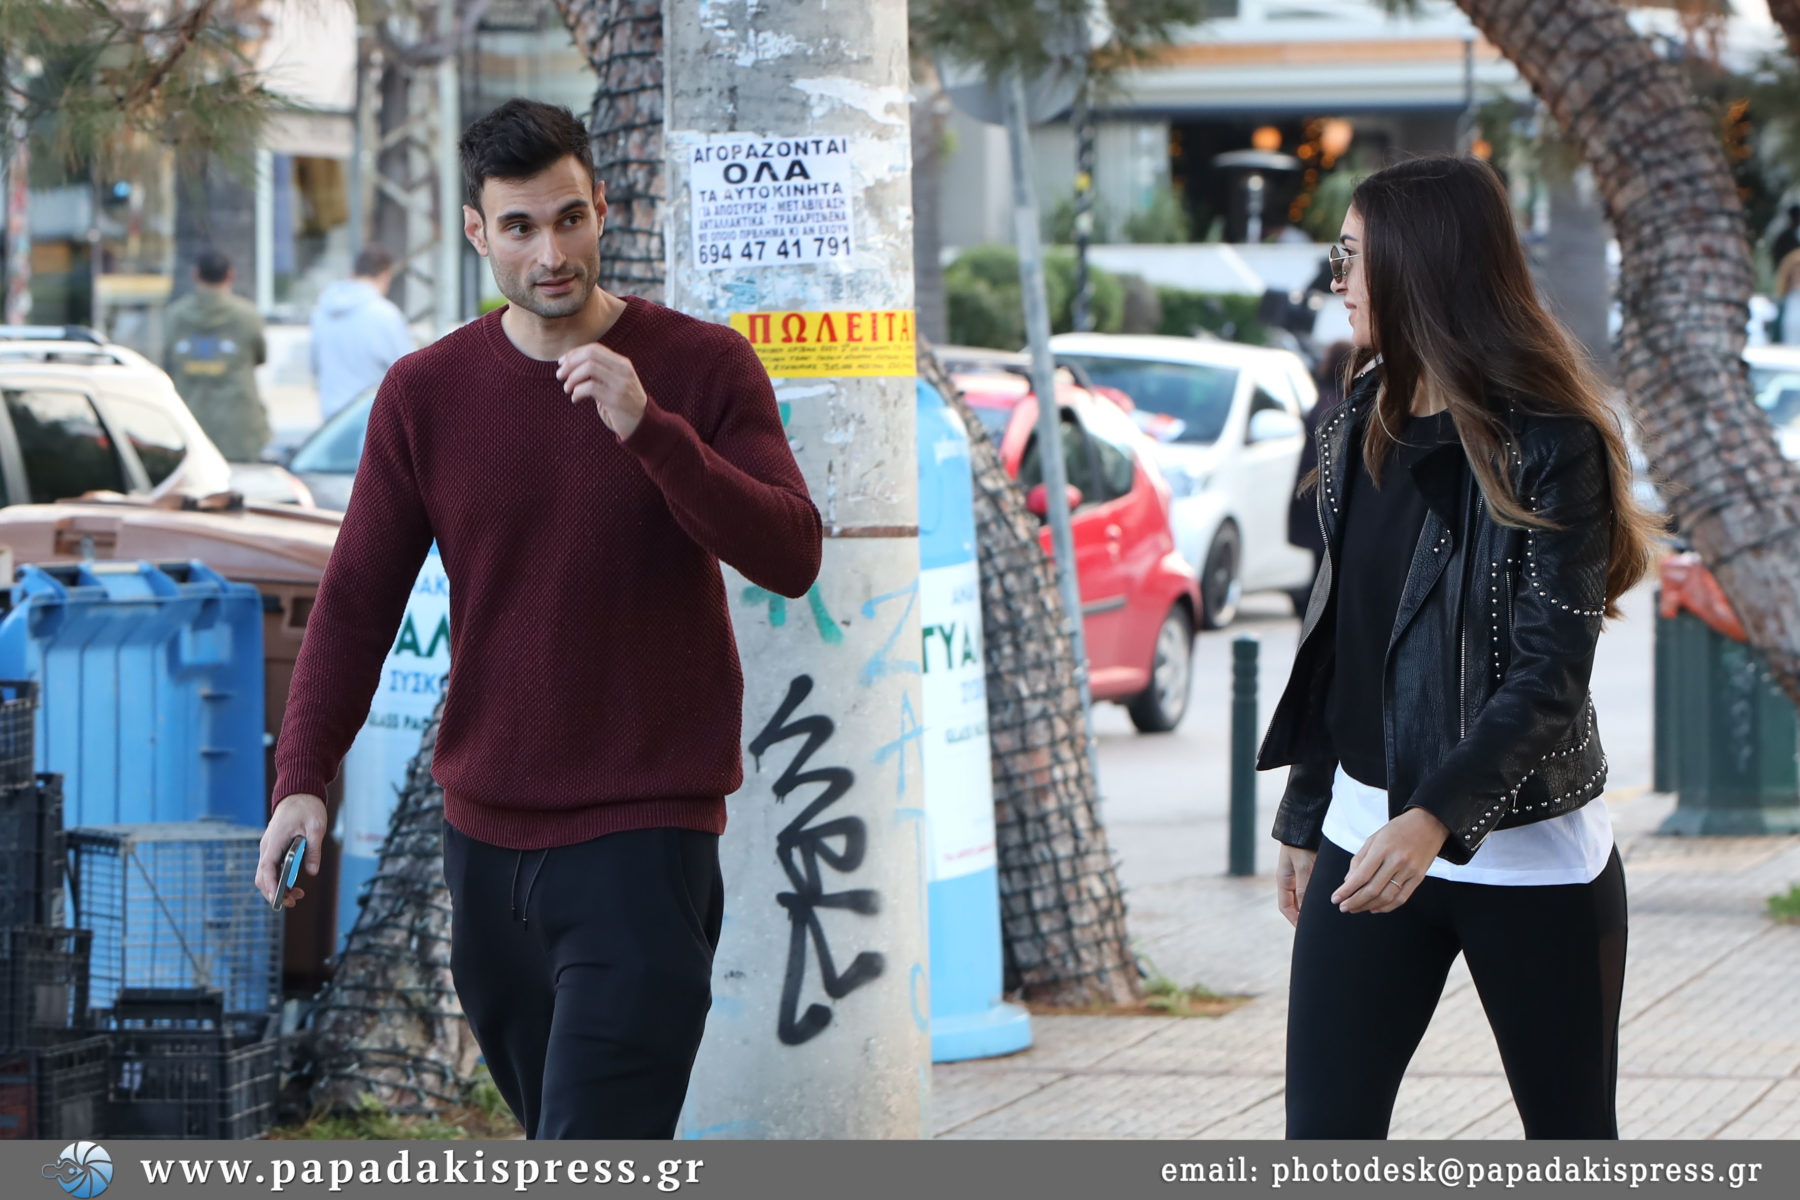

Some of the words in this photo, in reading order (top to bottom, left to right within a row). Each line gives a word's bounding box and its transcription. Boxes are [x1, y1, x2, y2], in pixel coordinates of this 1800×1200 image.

[694, 139, 847, 163] ΑΓΟΡΑΖΟΝΤΑΙ
[723, 159, 811, 184] ΟΛΑ
[700, 189, 717, 203] ΤΑ
[723, 182, 843, 201] ΑΥΤΟΚΙΝΗΤΑ
[699, 243, 732, 264] 694
[741, 241, 767, 261] 47
[777, 238, 801, 259] 41
[813, 236, 850, 257] 791
